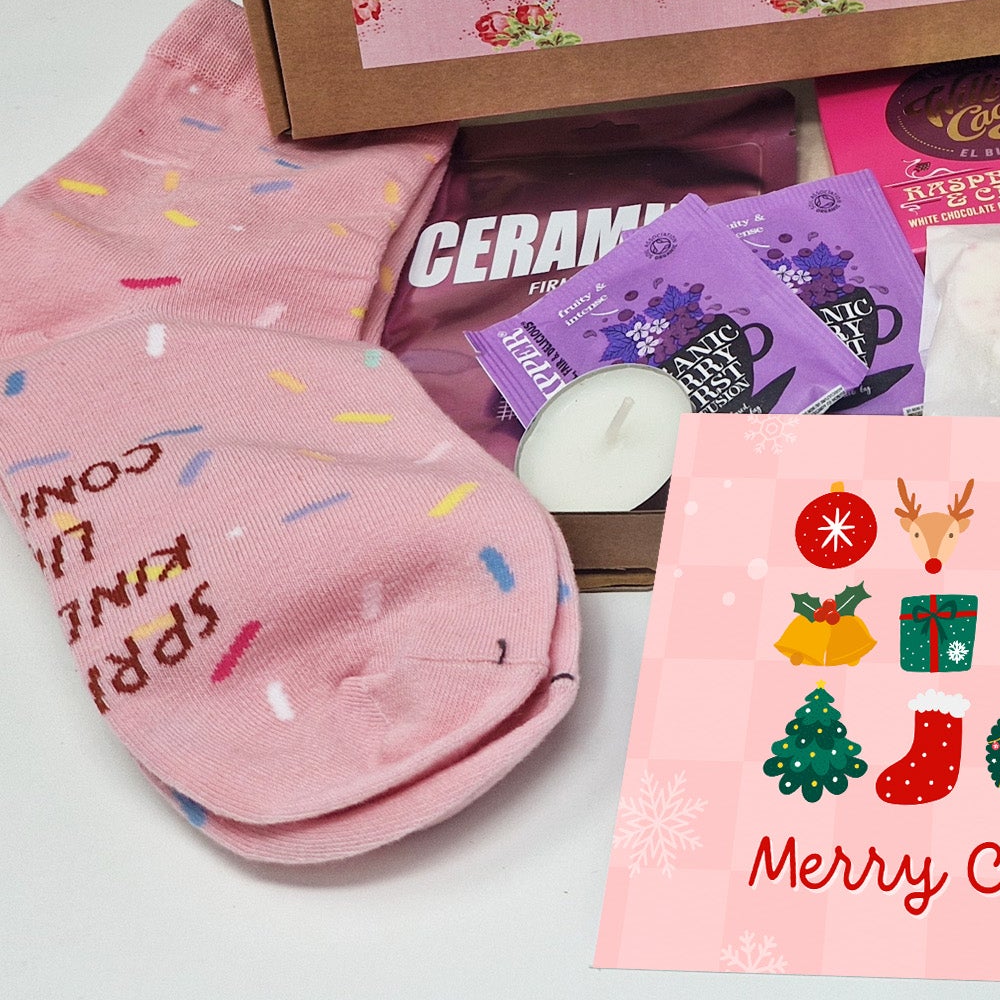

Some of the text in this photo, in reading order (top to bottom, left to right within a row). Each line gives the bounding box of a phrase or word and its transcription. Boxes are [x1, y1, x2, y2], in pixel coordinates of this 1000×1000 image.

[960, 148, 979, 158] EL
[946, 192, 967, 208] &
[754, 213, 766, 222] &
[908, 213, 939, 229] WHITE
[940, 202, 996, 222] CHOCOLATE
[408, 203, 678, 288] CERAM
[558, 282, 607, 319] fruity &
[565, 294, 609, 327] intense
[819, 298, 873, 325] NIC
[556, 357, 573, 377] FAIR
[30, 520, 95, 579] LI
[748, 834, 949, 917] Merry
